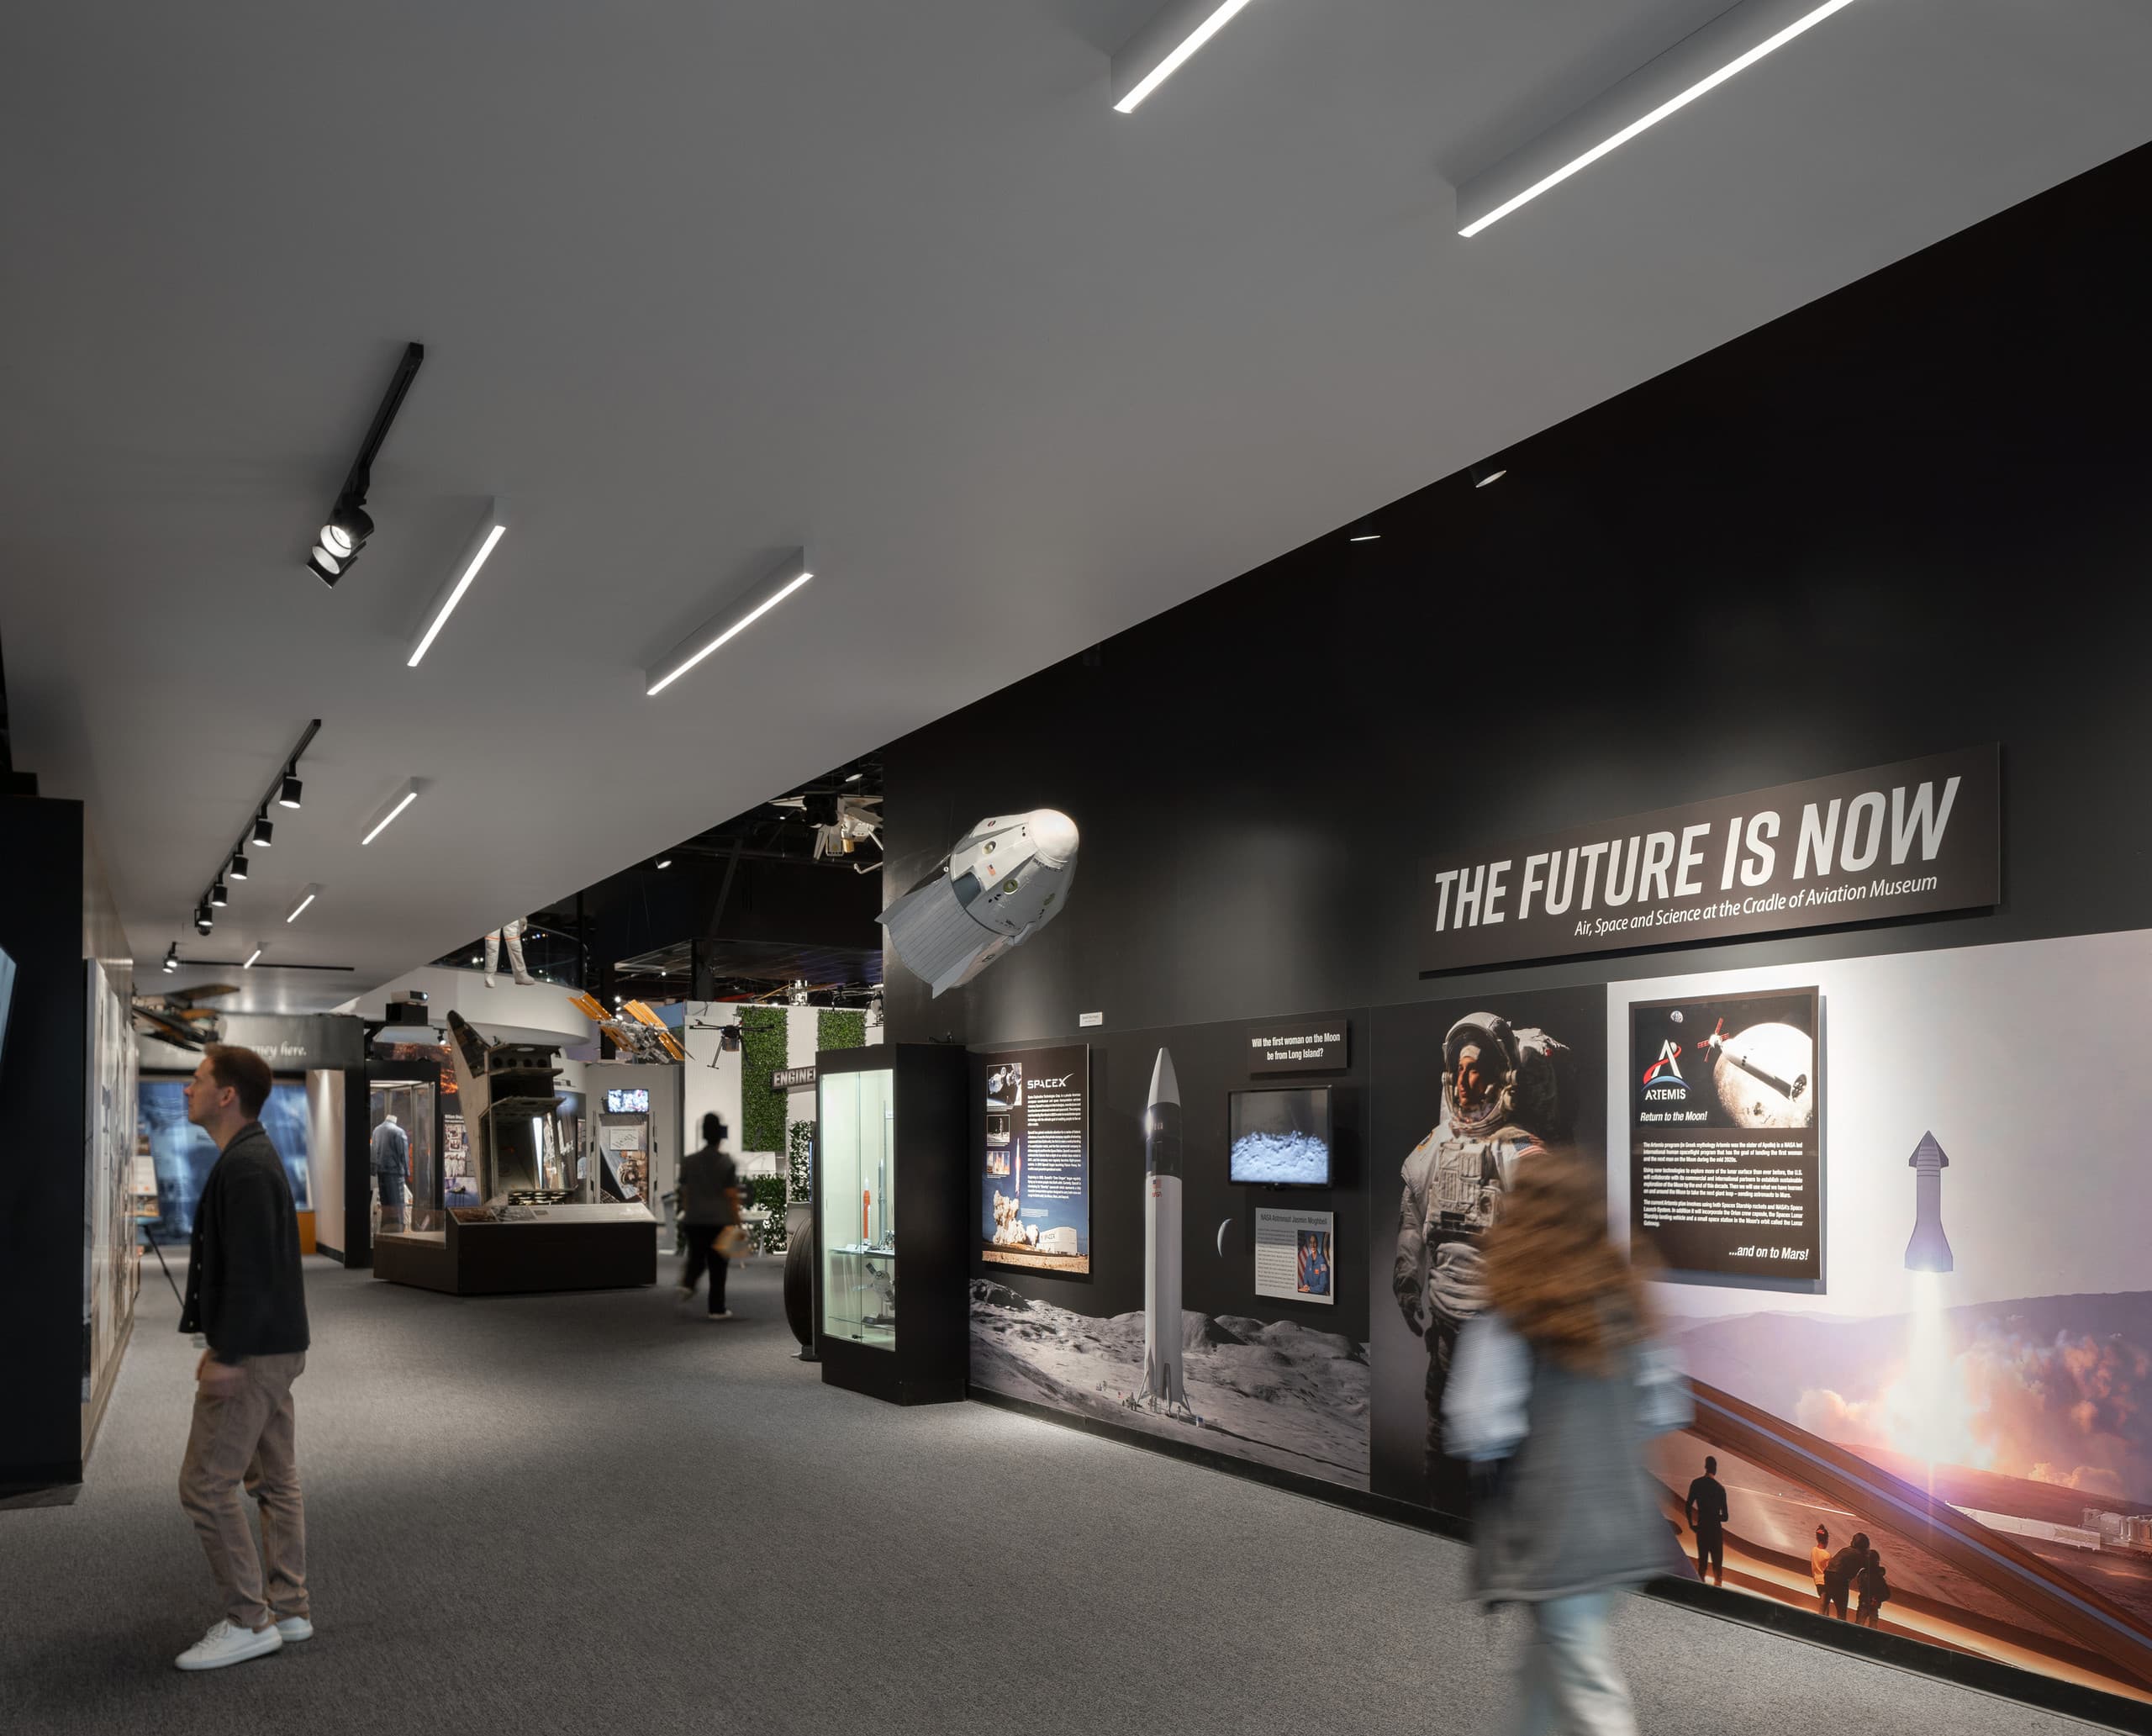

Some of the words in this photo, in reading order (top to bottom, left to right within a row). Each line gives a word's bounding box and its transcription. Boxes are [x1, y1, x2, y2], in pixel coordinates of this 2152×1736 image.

[1435, 860, 1511, 931] THE
[1519, 823, 1710, 919] FUTURE
[1721, 810, 1780, 890] IS
[1793, 776, 1961, 879] NOW
[1574, 921, 1592, 936] Air,
[1595, 917, 1627, 936] Space
[1631, 910, 1654, 928] and
[1655, 908, 1700, 925] Science
[1703, 904, 1716, 919] at
[1719, 900, 1740, 916] the
[1743, 893, 1785, 914] Cradle
[1789, 889, 1805, 908] of
[1806, 884, 1866, 906] Aviation
[1870, 876, 1937, 897] Museum
[1252, 1038, 1262, 1047] Will
[1263, 1038, 1271, 1047] the
[1272, 1037, 1284, 1046] first
[1314, 1034, 1322, 1042] the
[1324, 1032, 1340, 1042] Moon
[1267, 1052, 1274, 1060] be
[1274, 1051, 1287, 1060] from
[1289, 1050, 1301, 1060] Long
[1303, 1047, 1323, 1058] Island?
[774, 1067, 815, 1086] ENGINE
[1645, 1089, 1686, 1100] ARTEMIS
[1640, 1111, 1663, 1121] Return
[1664, 1111, 1671, 1121] to
[1673, 1111, 1684, 1121] the
[1685, 1111, 1707, 1121] Moon!
[1729, 1245, 1755, 1257] ...and
[1756, 1248, 1768, 1258] on
[1770, 1247, 1780, 1258] to
[1781, 1247, 1809, 1260] Mars!
